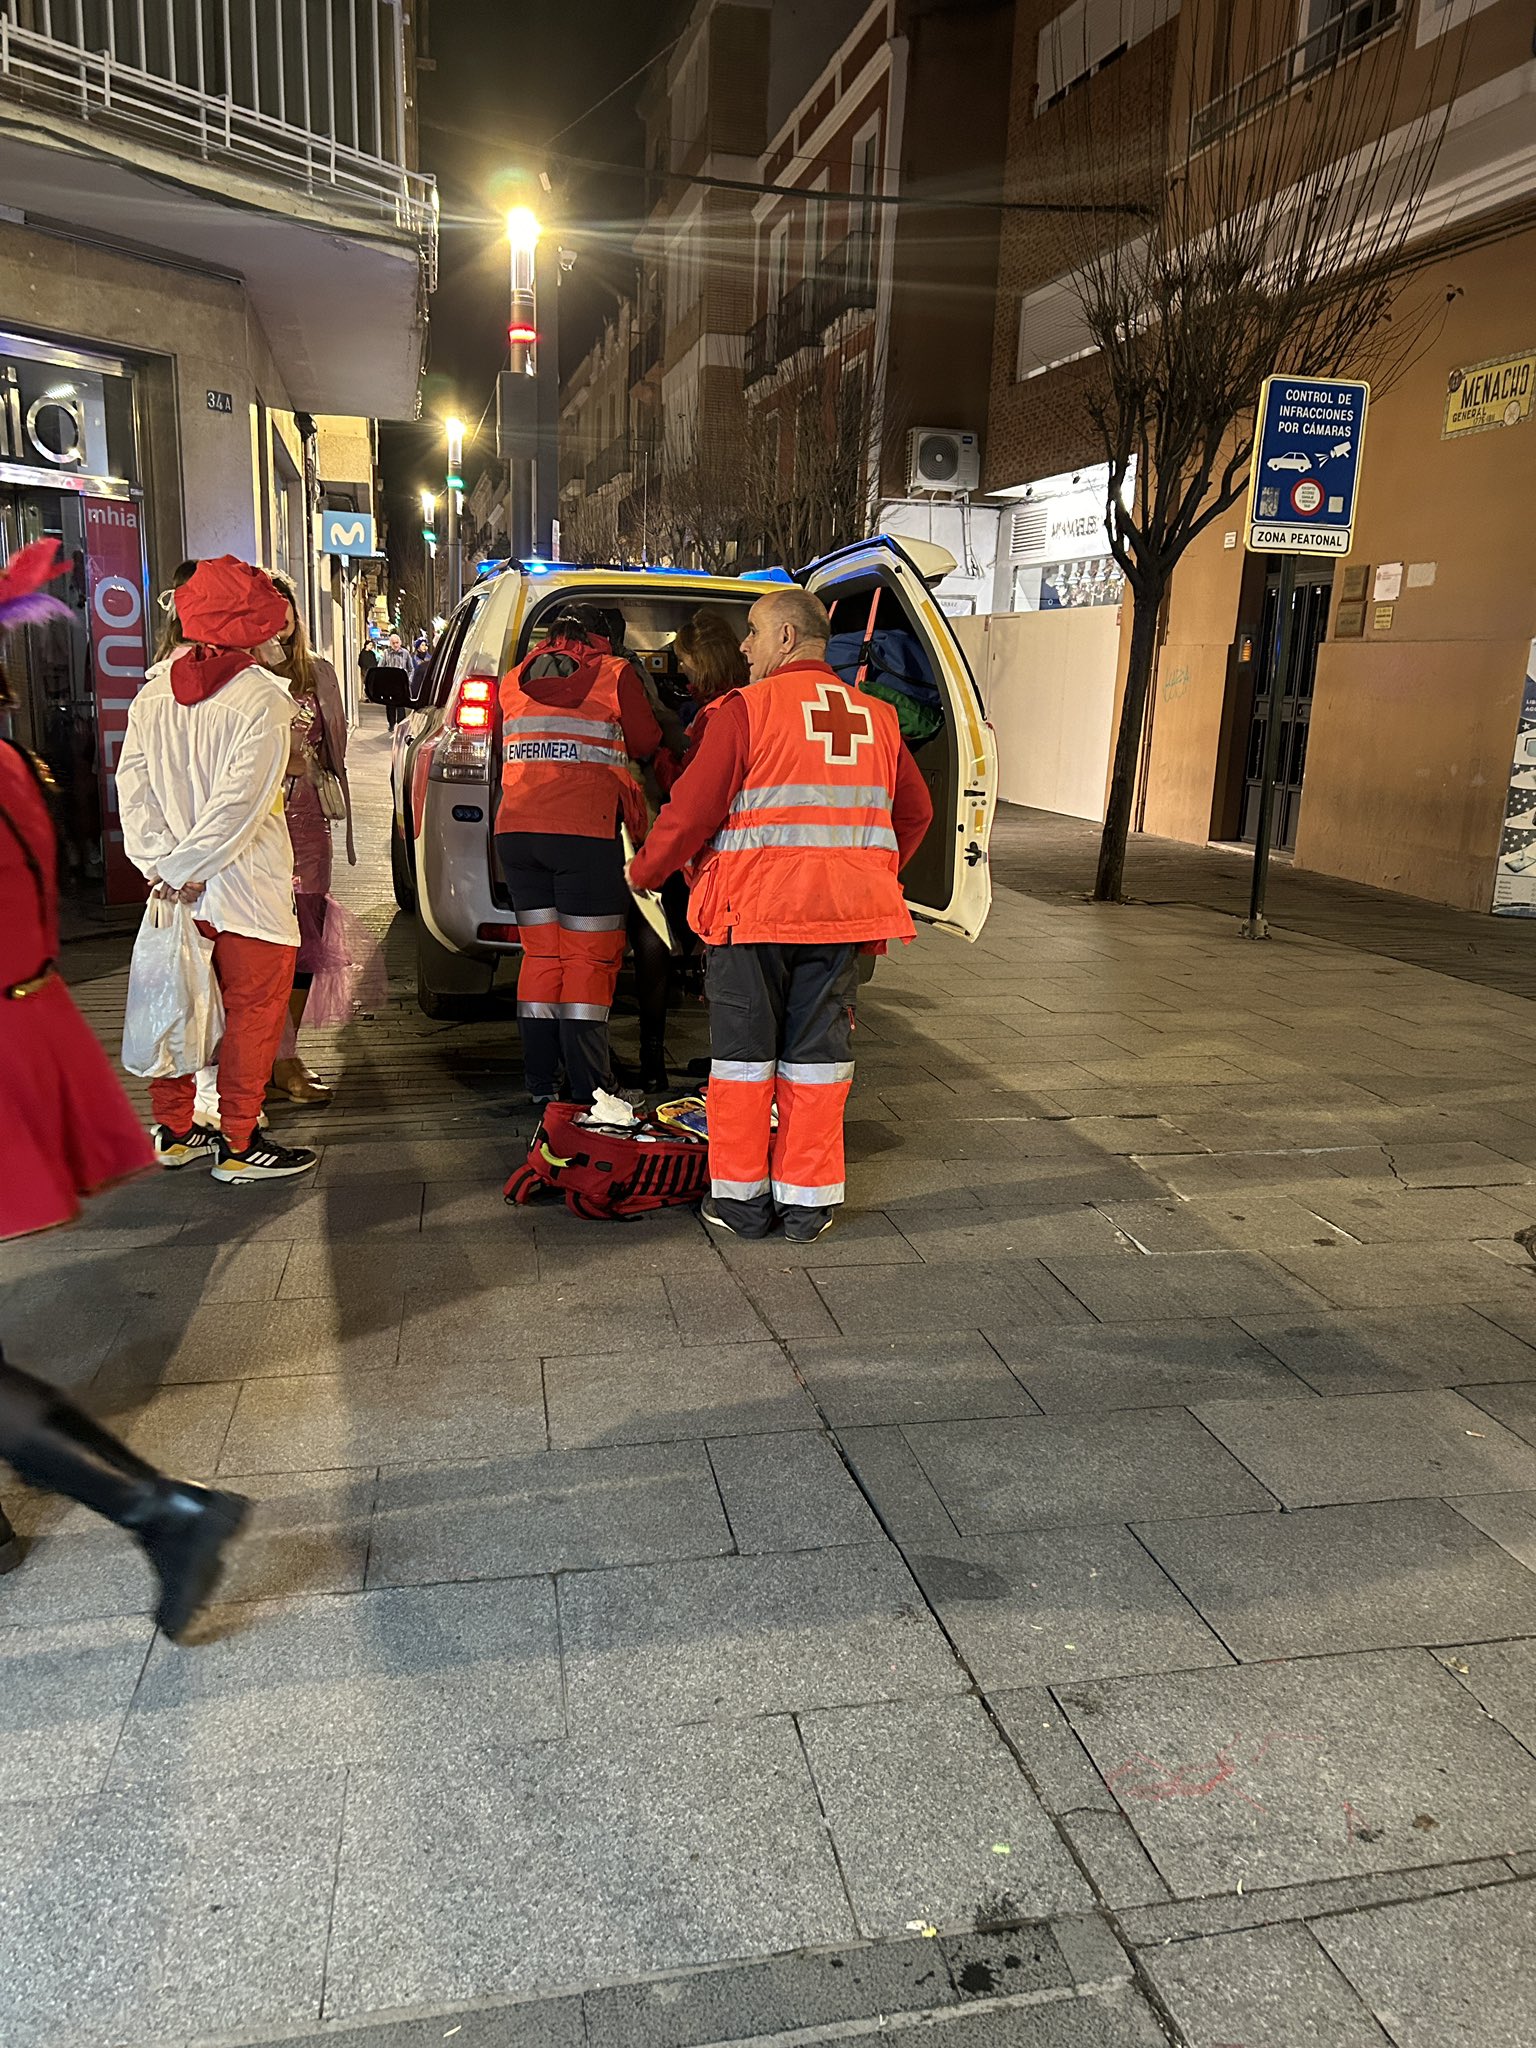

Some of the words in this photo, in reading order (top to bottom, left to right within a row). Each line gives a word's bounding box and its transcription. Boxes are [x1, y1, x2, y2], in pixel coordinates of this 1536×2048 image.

[1460, 364, 1530, 410] MENACHO
[1285, 389, 1334, 404] CONTROL
[1338, 393, 1352, 405] DE
[1279, 406, 1354, 421] INFRACCIONES
[1452, 407, 1487, 422] GENERAL
[1278, 421, 1299, 434] POR
[1303, 422, 1351, 438] CÁMARAS
[87, 504, 138, 528] mhia
[1257, 531, 1286, 543] ZONA
[1290, 533, 1342, 547] PEATONAL
